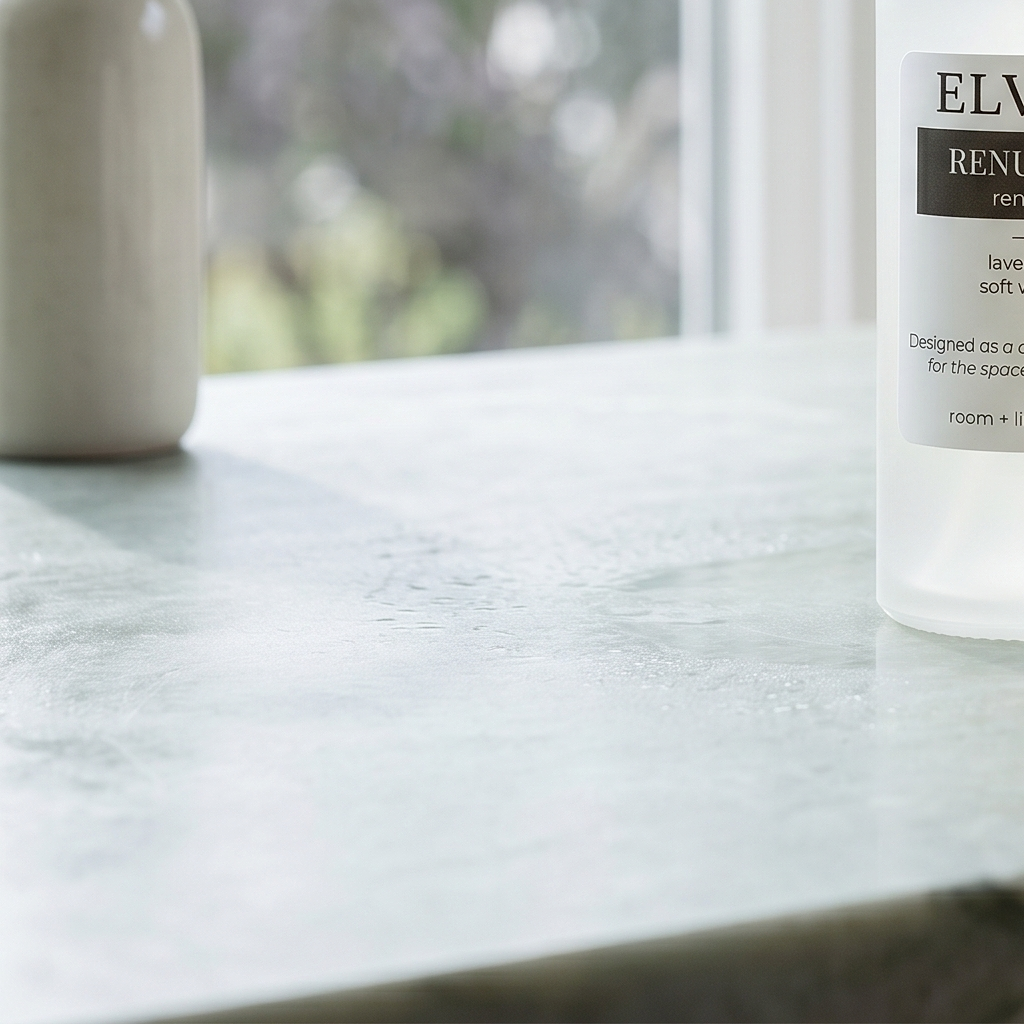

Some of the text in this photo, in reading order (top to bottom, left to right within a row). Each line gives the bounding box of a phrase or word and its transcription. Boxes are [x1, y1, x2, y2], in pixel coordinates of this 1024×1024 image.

[979, 279, 1013, 294] soft
[909, 333, 975, 355] Designed
[979, 341, 998, 353] as
[1002, 342, 1013, 354] a
[927, 358, 947, 373] for
[951, 360, 976, 375] the
[949, 411, 993, 425] room
